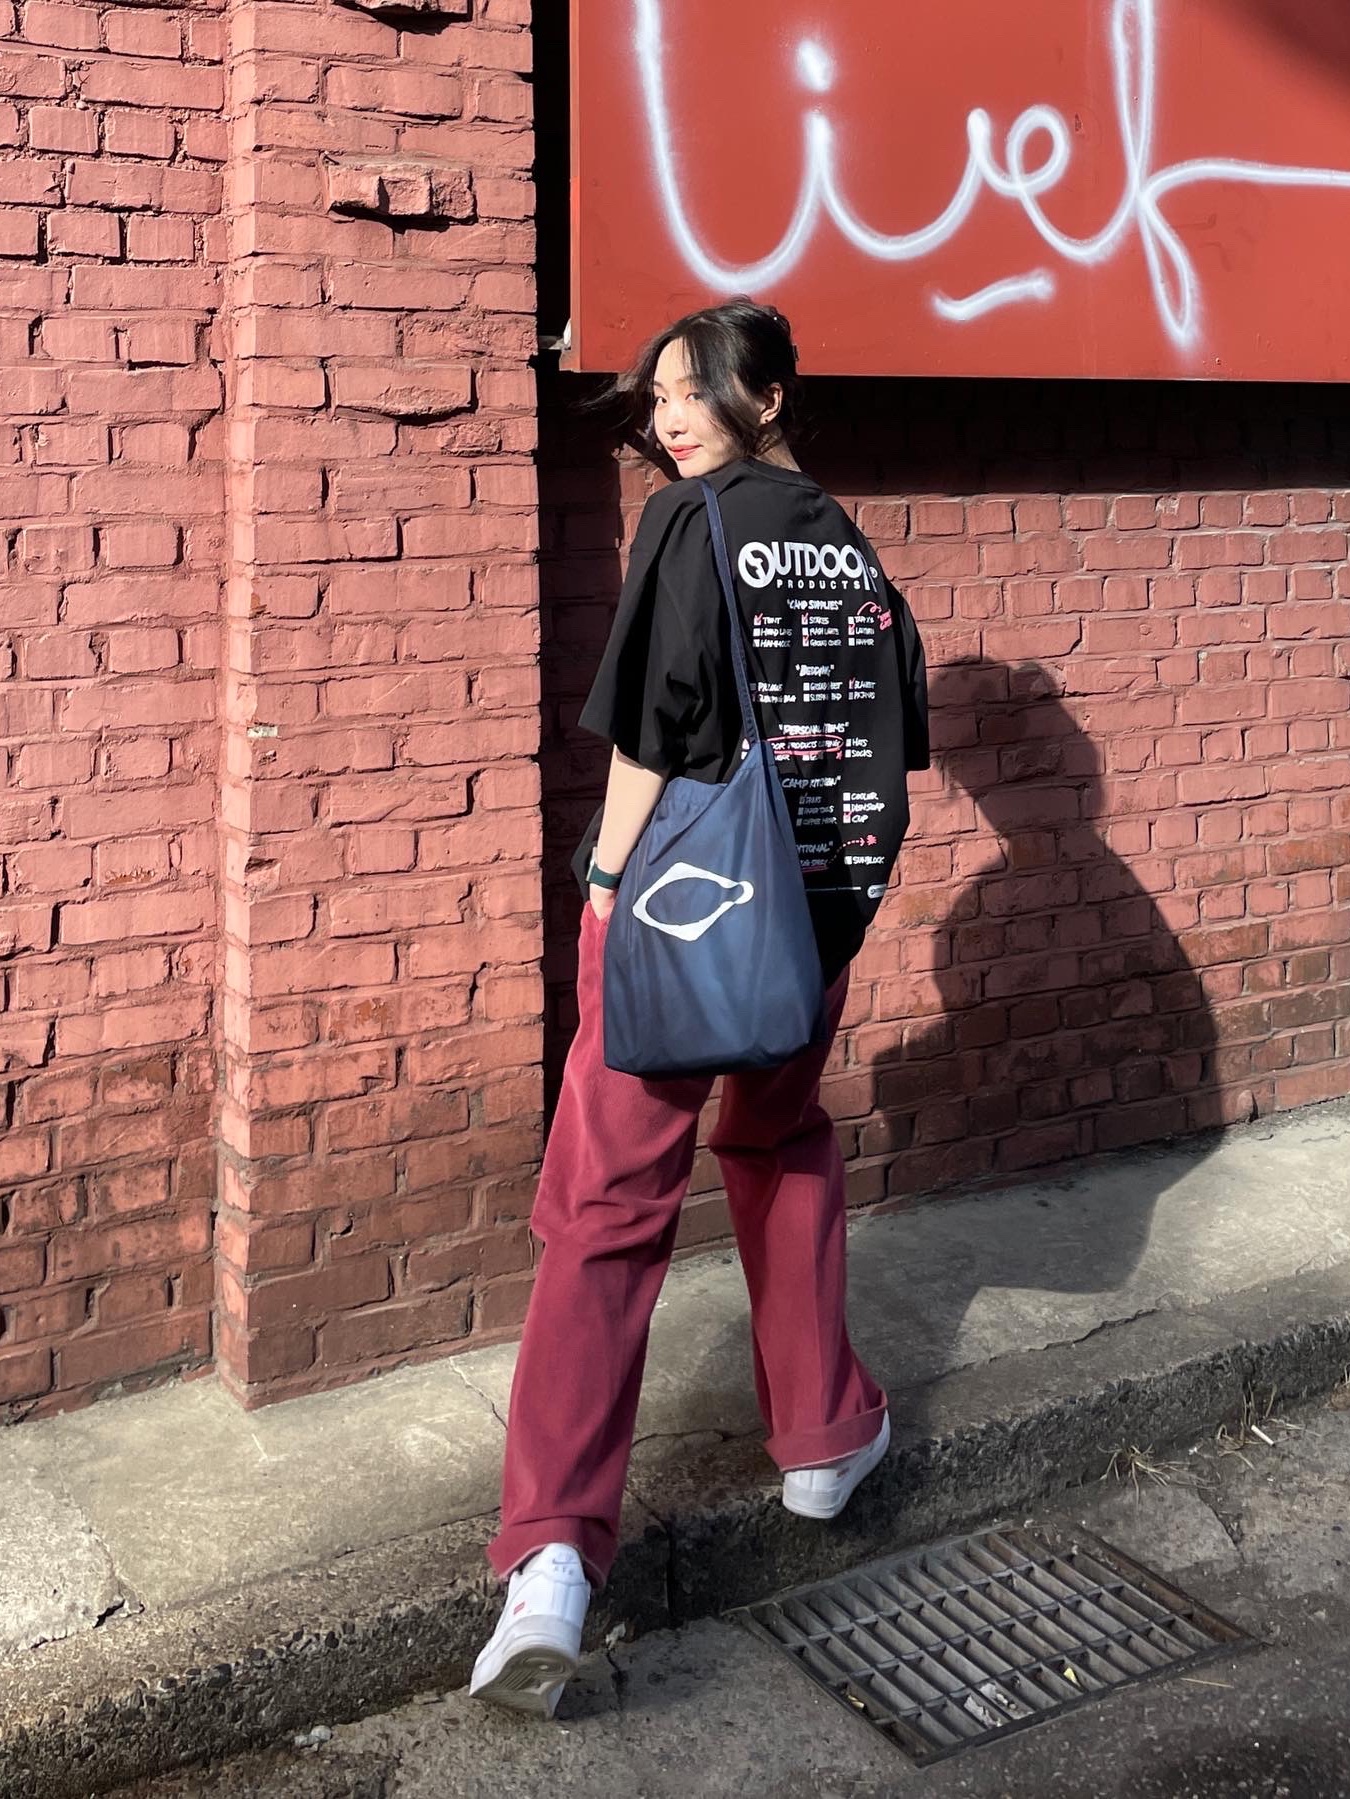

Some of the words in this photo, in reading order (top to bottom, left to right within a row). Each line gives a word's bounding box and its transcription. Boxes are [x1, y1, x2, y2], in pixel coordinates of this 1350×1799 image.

[776, 579, 861, 590] PRODUCTS
[851, 749, 873, 758] SOCKS
[851, 814, 869, 824] CUP
